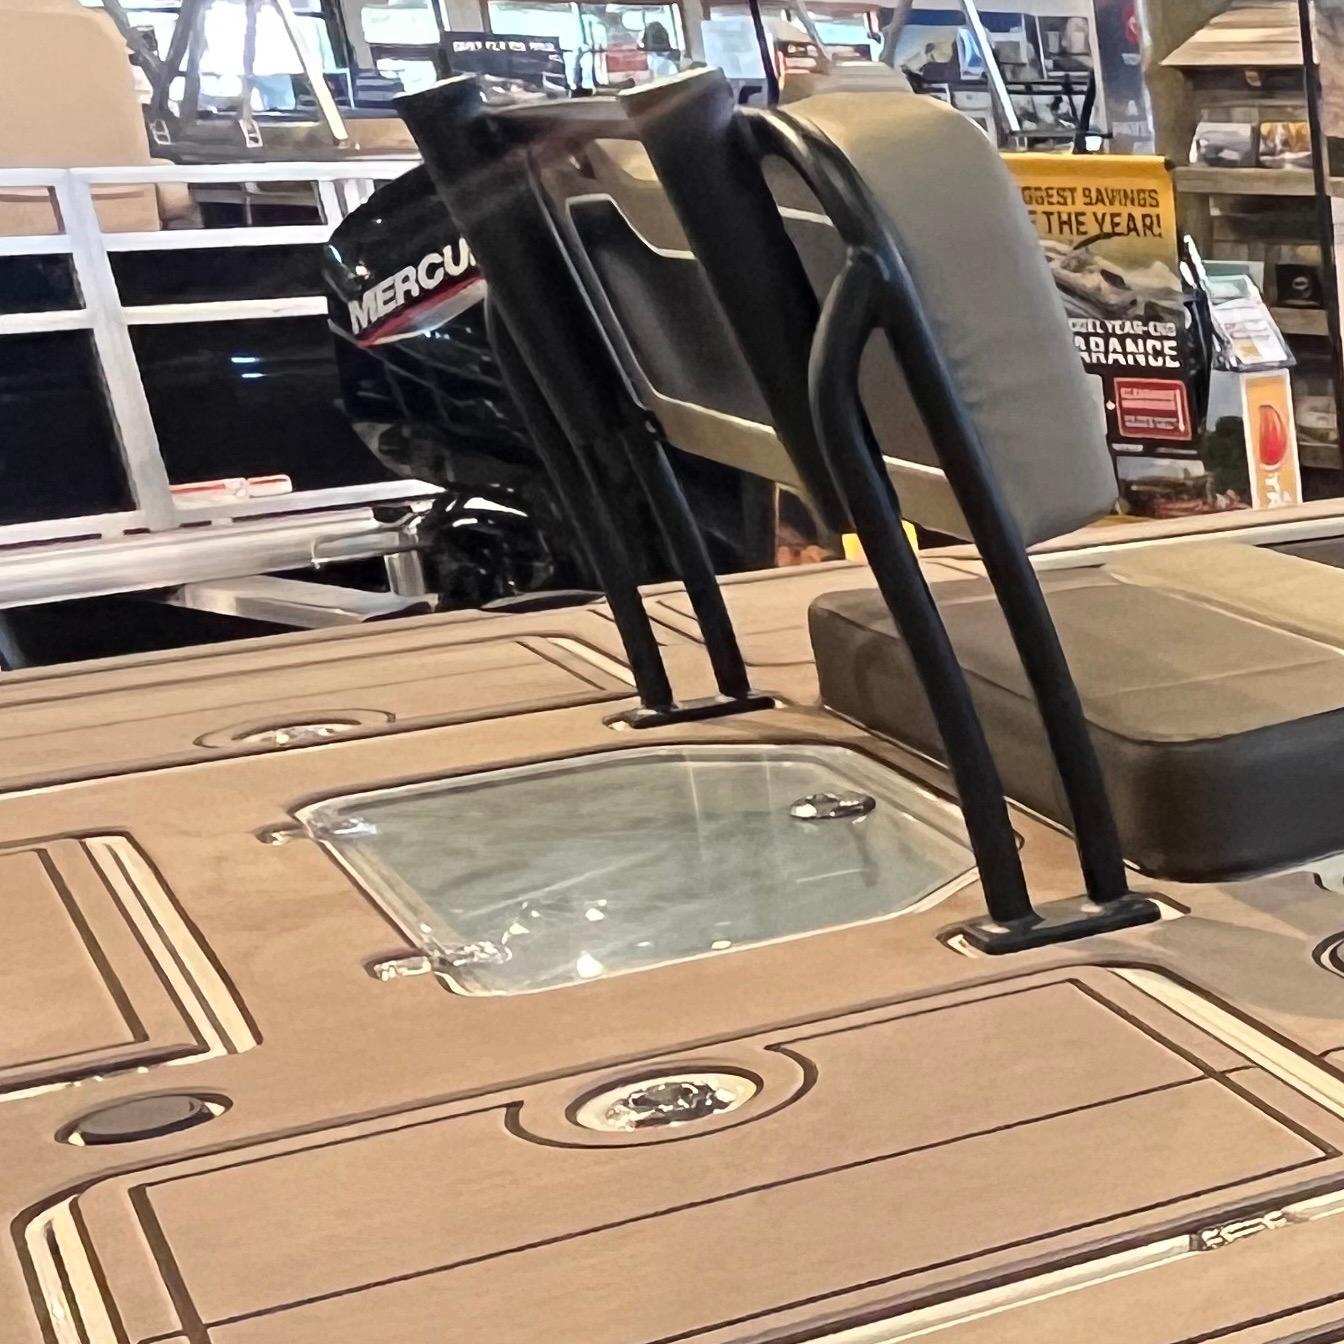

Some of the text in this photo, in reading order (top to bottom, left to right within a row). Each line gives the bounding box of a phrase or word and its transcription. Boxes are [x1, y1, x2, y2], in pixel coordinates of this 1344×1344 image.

[1020, 186, 1160, 208] GGEST SAVINGS
[1044, 211, 1089, 236] THE
[1092, 212, 1163, 238] YEAR!
[348, 236, 477, 335] MERCU
[1074, 335, 1181, 368] ARANCE
